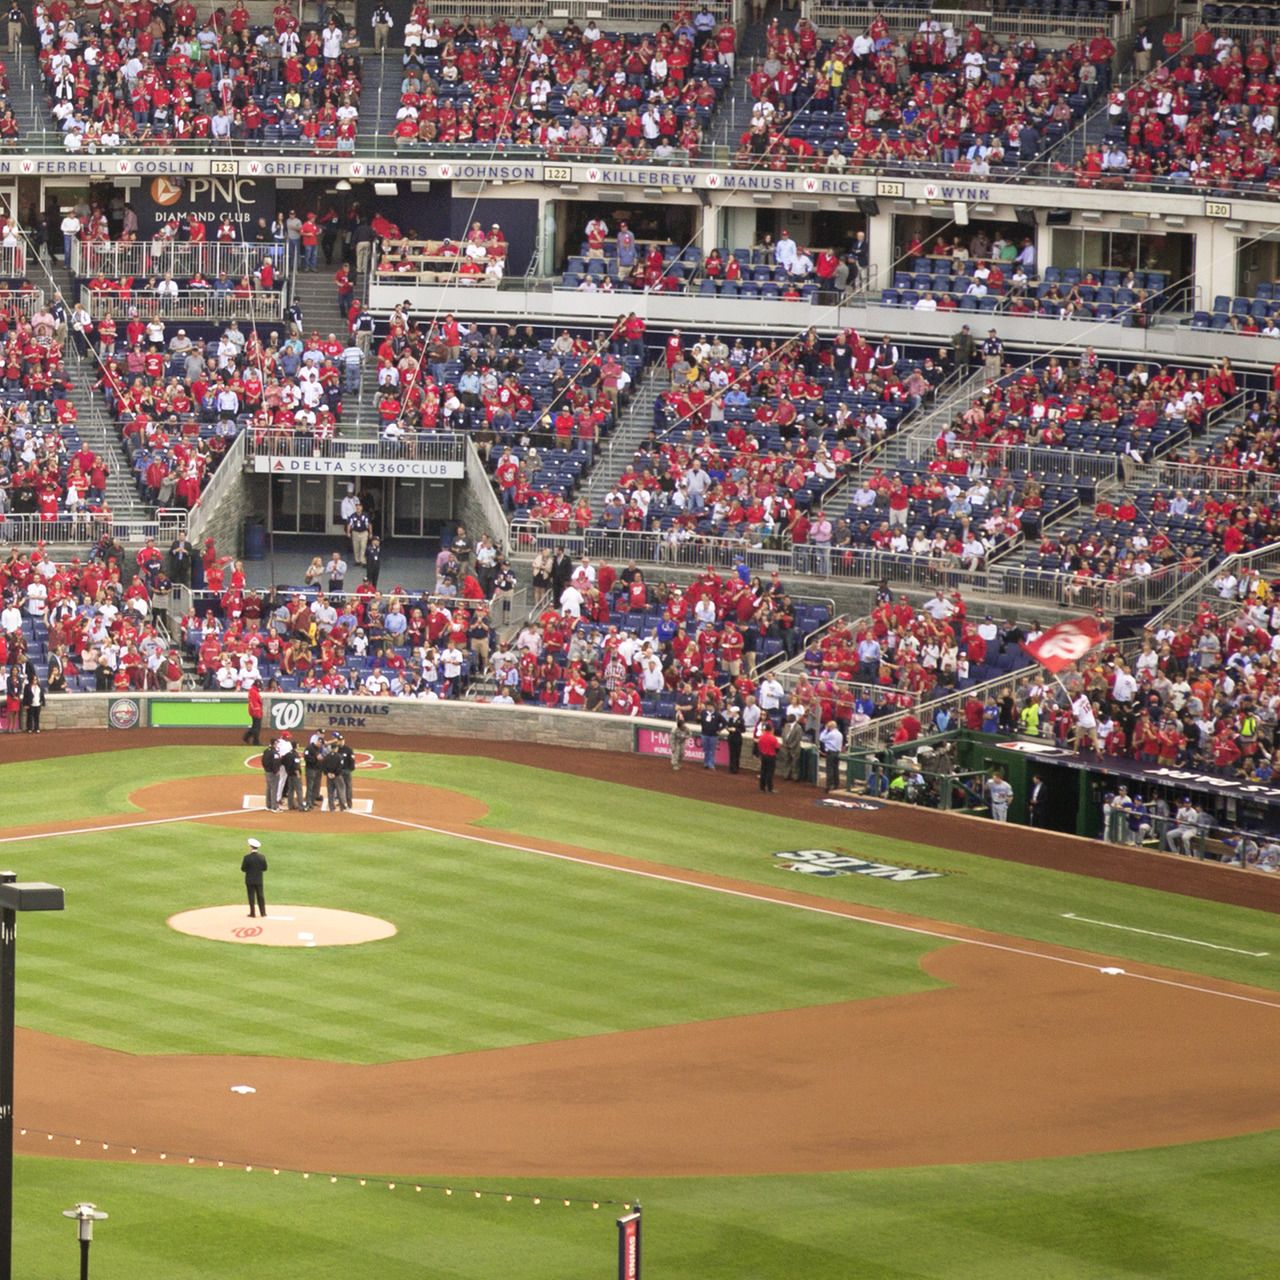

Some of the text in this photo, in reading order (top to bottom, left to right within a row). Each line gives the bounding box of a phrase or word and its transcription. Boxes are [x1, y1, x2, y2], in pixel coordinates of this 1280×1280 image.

[37, 161, 106, 172] FERRELL
[134, 161, 194, 173] GOSLIN
[215, 163, 234, 173] 123
[264, 163, 339, 175] GRIFFITH
[366, 165, 427, 177] HARRIS
[454, 166, 535, 178] JOHNSON
[548, 169, 567, 179] 122
[603, 172, 696, 185] KILLEBREW
[724, 176, 795, 189] MANUSH
[822, 181, 860, 193] RICE
[188, 178, 256, 203] PNC
[881, 184, 899, 194] 121
[941, 187, 989, 200] WYNN
[1209, 205, 1227, 215] 120
[219, 212, 251, 223] CLUB
[290, 460, 343, 472] DELTA
[272, 700, 390, 730] W NATIONALS
[328, 717, 366, 727] PARK
